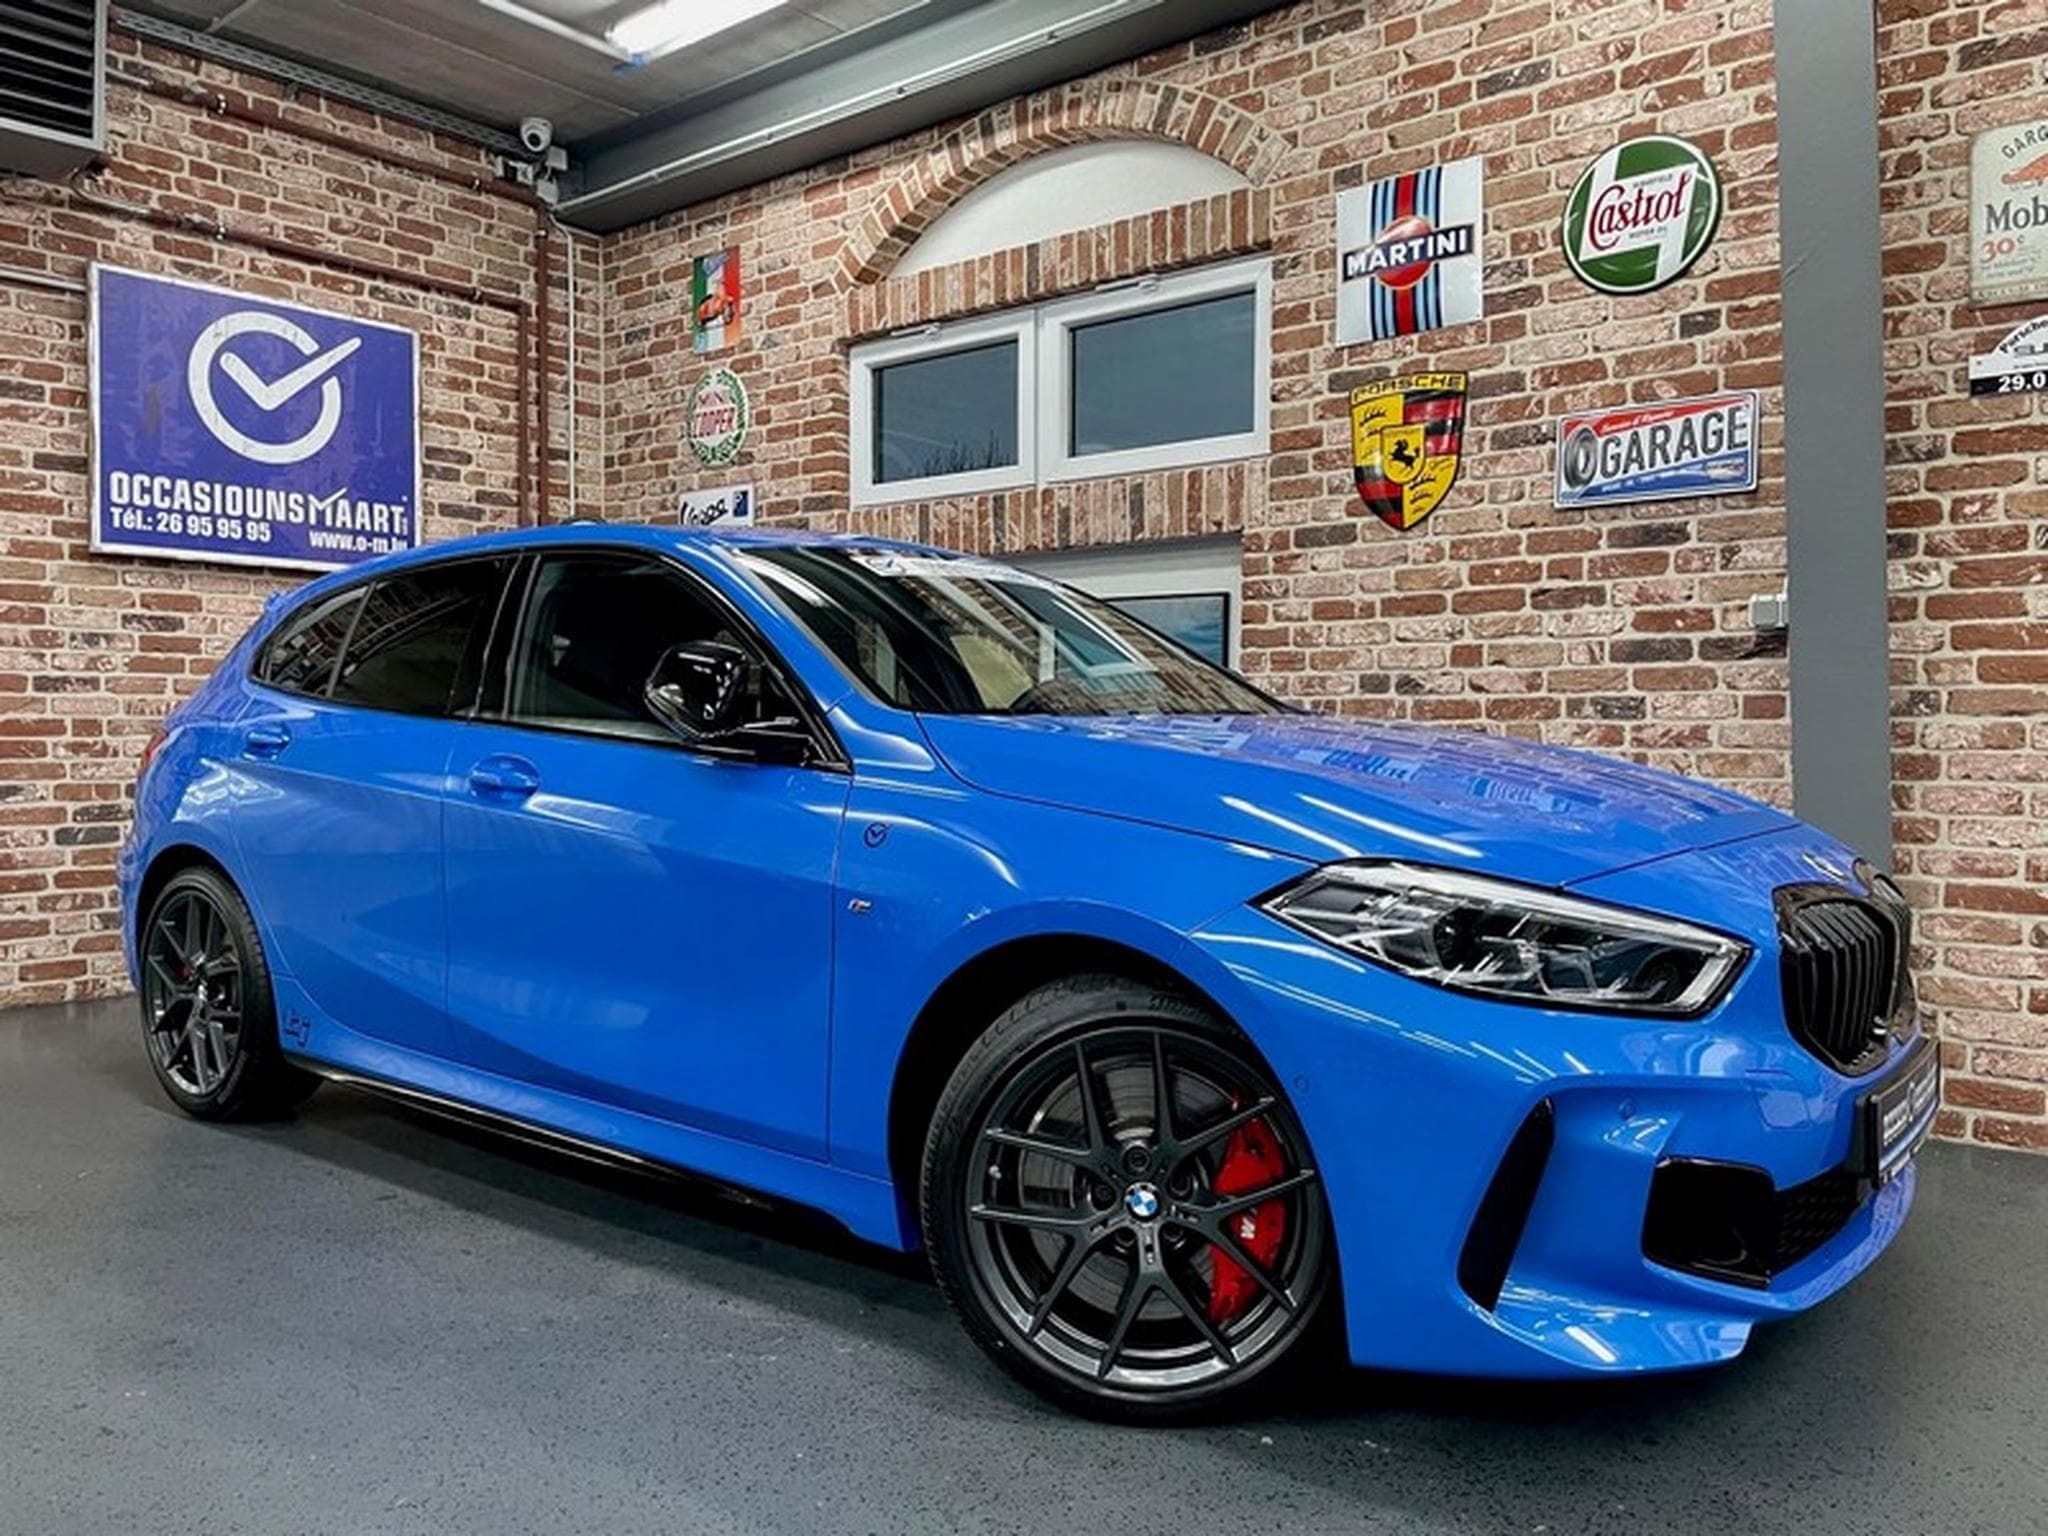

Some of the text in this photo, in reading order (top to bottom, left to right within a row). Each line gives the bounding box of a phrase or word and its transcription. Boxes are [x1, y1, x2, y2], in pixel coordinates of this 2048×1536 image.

[1589, 170, 1692, 252] Castrol
[1346, 229, 1466, 276] MARTINI
[1353, 375, 1462, 402] PORSCHE
[1600, 406, 1749, 479] GARAGE
[110, 471, 404, 534] OCCASIOUNSMAART
[110, 507, 271, 543] Tél.: 26 95 95 95
